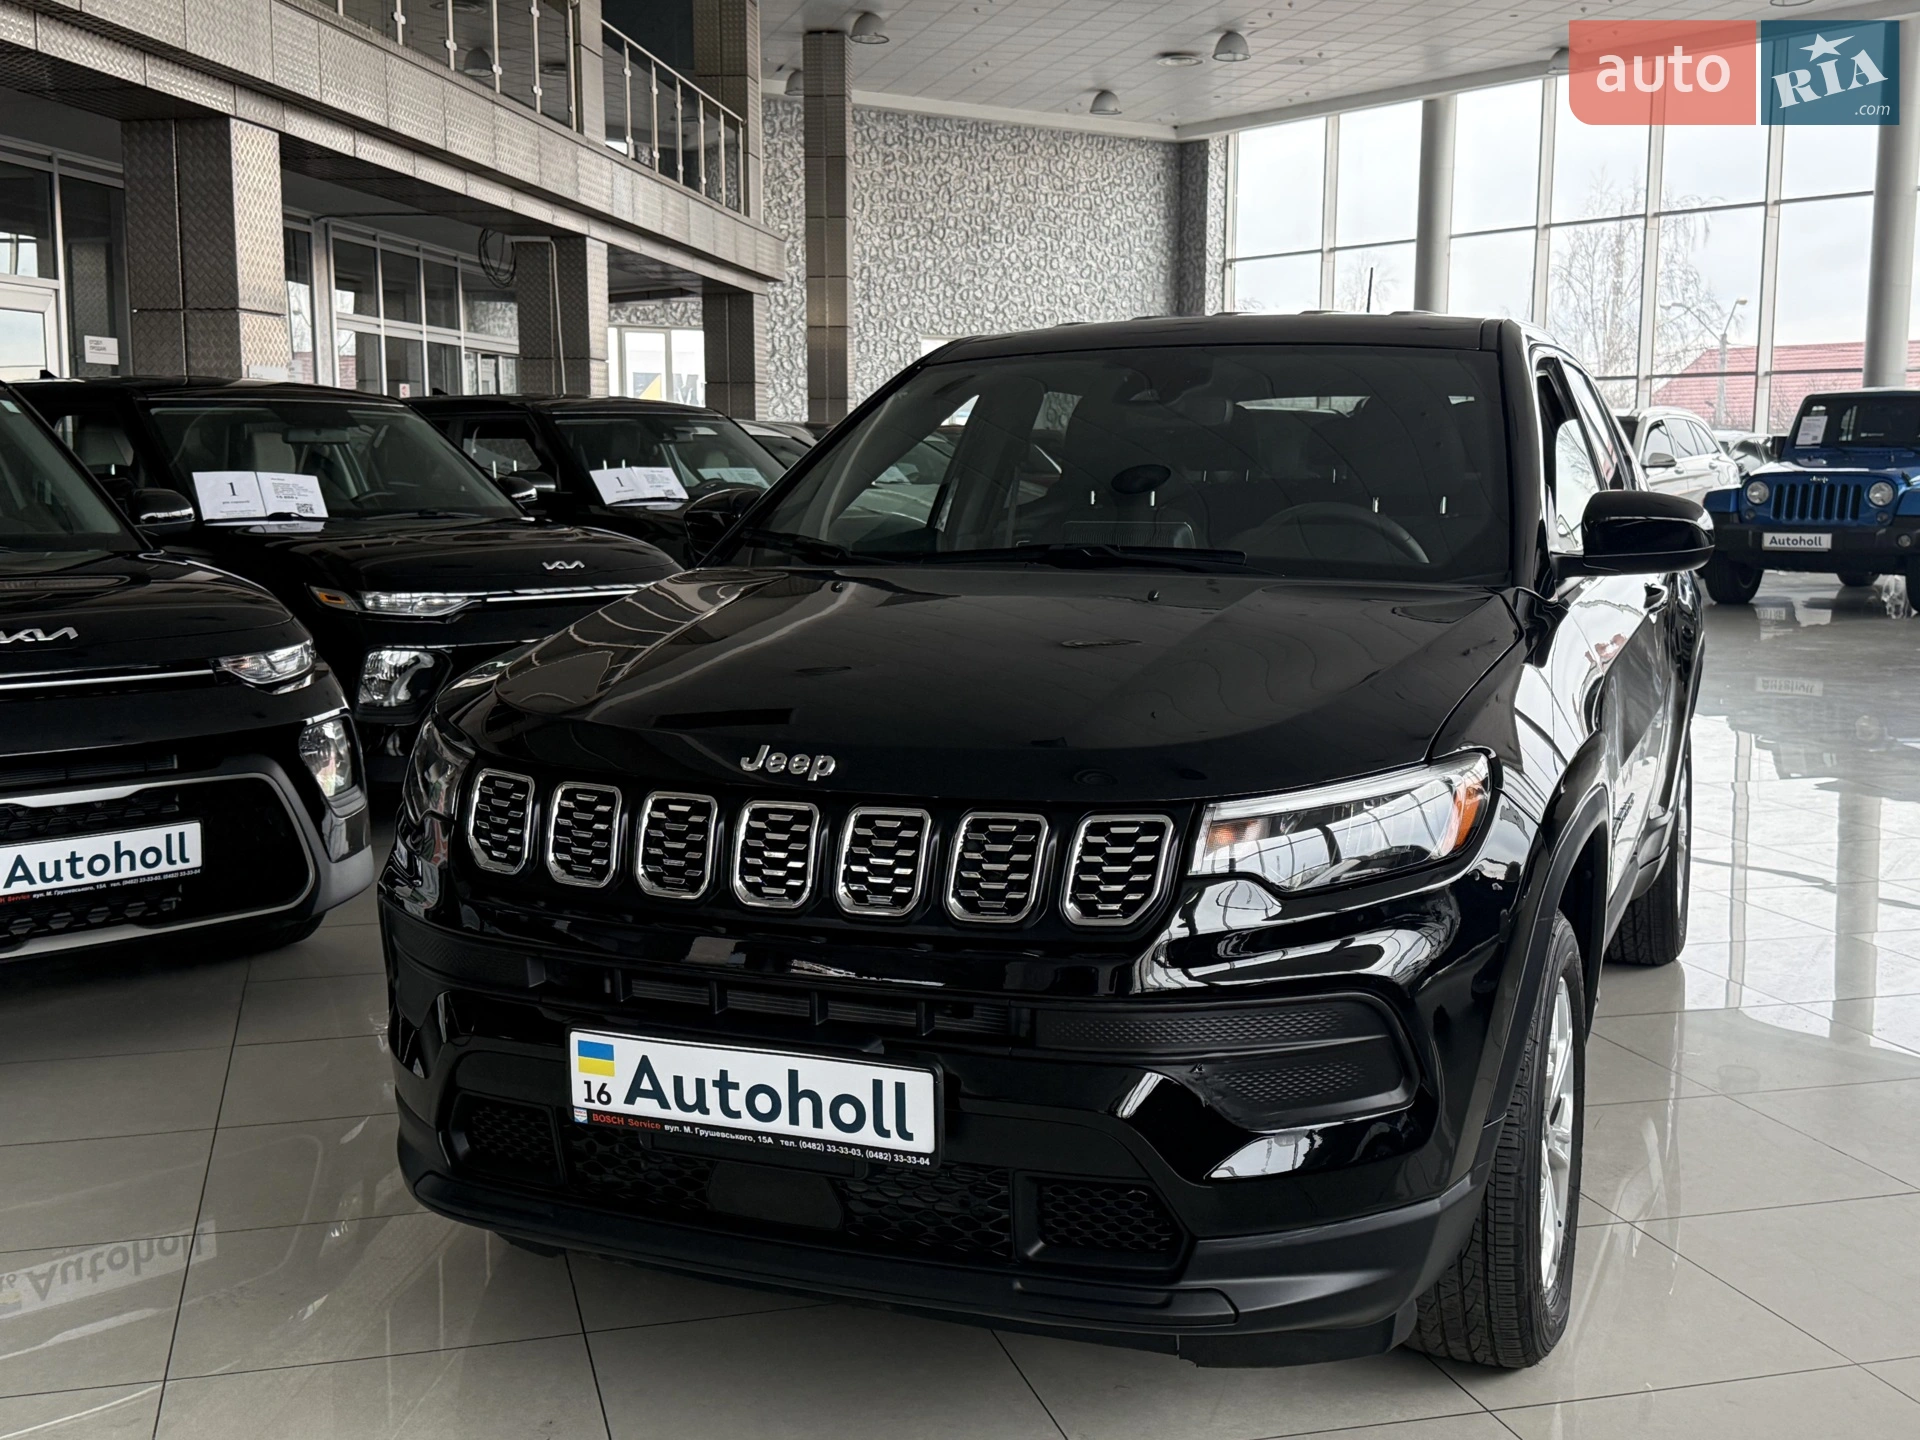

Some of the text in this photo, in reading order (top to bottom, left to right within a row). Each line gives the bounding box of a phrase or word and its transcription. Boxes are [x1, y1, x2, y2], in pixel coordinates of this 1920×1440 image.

[1769, 535, 1823, 547] Autoholl
[740, 744, 836, 781] Jeep
[3, 831, 191, 889] Autoholl
[583, 1080, 612, 1106] 16
[624, 1054, 914, 1141] Autoholl
[592, 1113, 625, 1126] BOSCH
[627, 1118, 661, 1130] Service
[664, 1124, 682, 1134] вул.
[695, 1127, 756, 1143] Грушевського,
[780, 1140, 797, 1148] тел.
[799, 1139, 825, 1152] (0482)
[826, 1144, 864, 1158] 33-33-03,
[865, 1149, 892, 1162] (0482)
[893, 1153, 931, 1166] 33-33-04
